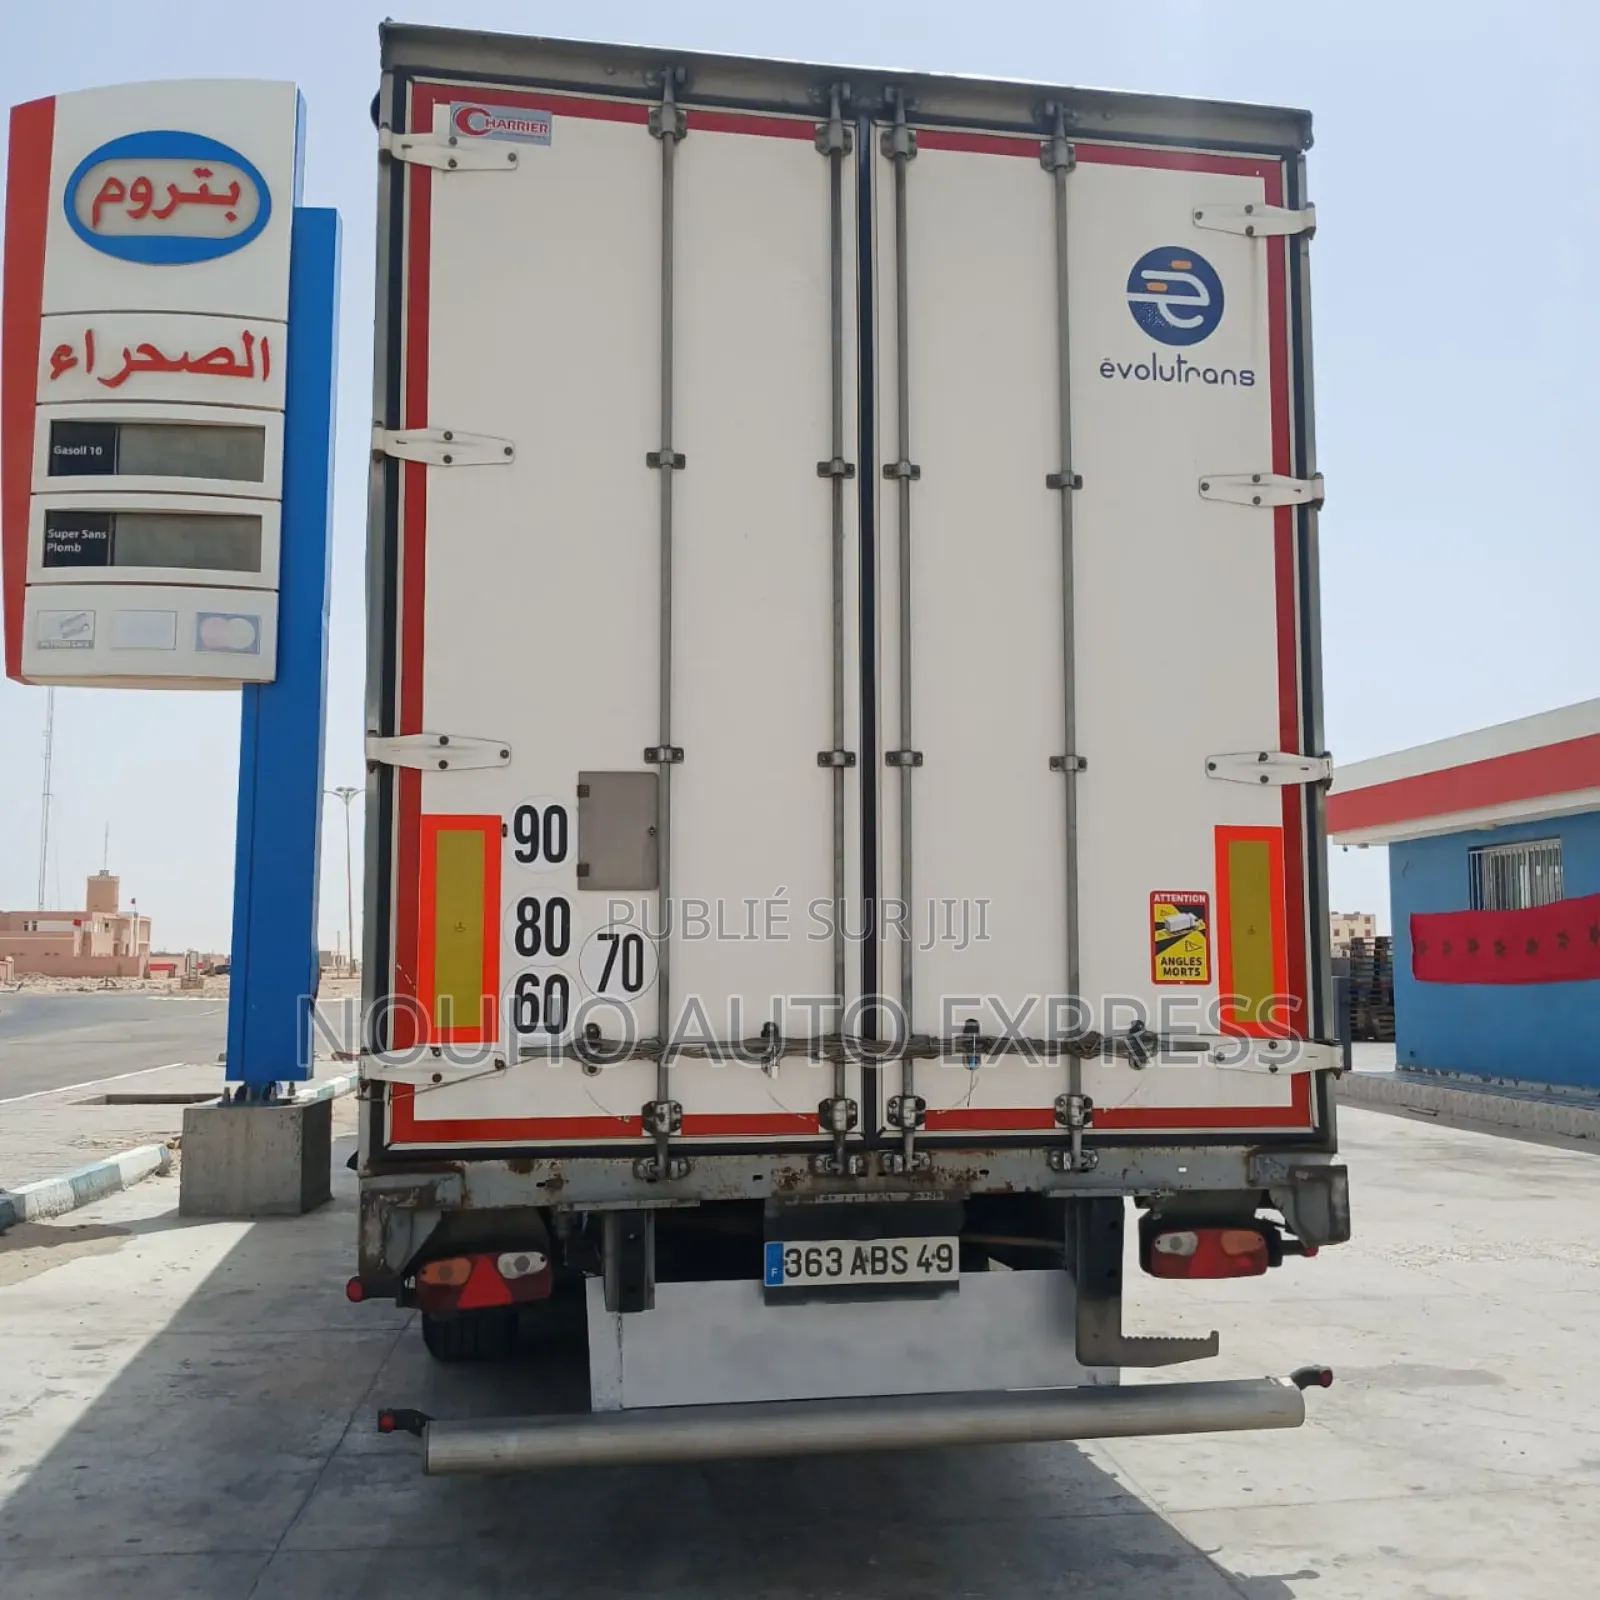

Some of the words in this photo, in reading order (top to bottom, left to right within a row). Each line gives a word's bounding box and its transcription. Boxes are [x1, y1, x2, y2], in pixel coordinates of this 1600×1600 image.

[453, 106, 549, 137] CHARRIER
[92, 167, 241, 229] بتروم
[49, 328, 271, 390] الصحراء
[54, 445, 87, 456] Gasoil
[90, 446, 103, 456] 10
[46, 543, 82, 553] Plomb
[47, 529, 79, 541] Super
[81, 529, 107, 540] Sans
[513, 804, 568, 863] 90
[1154, 894, 1206, 903] ATTENTION
[515, 897, 570, 957] 80
[597, 933, 643, 993] 70
[1161, 957, 1202, 966] ANGLES
[1163, 967, 1201, 976] MORTS
[513, 973, 570, 1034] 60
[771, 1268, 778, 1277] F
[784, 1247, 843, 1277] 363
[850, 1245, 908, 1276] ABS
[916, 1243, 954, 1274] 49
